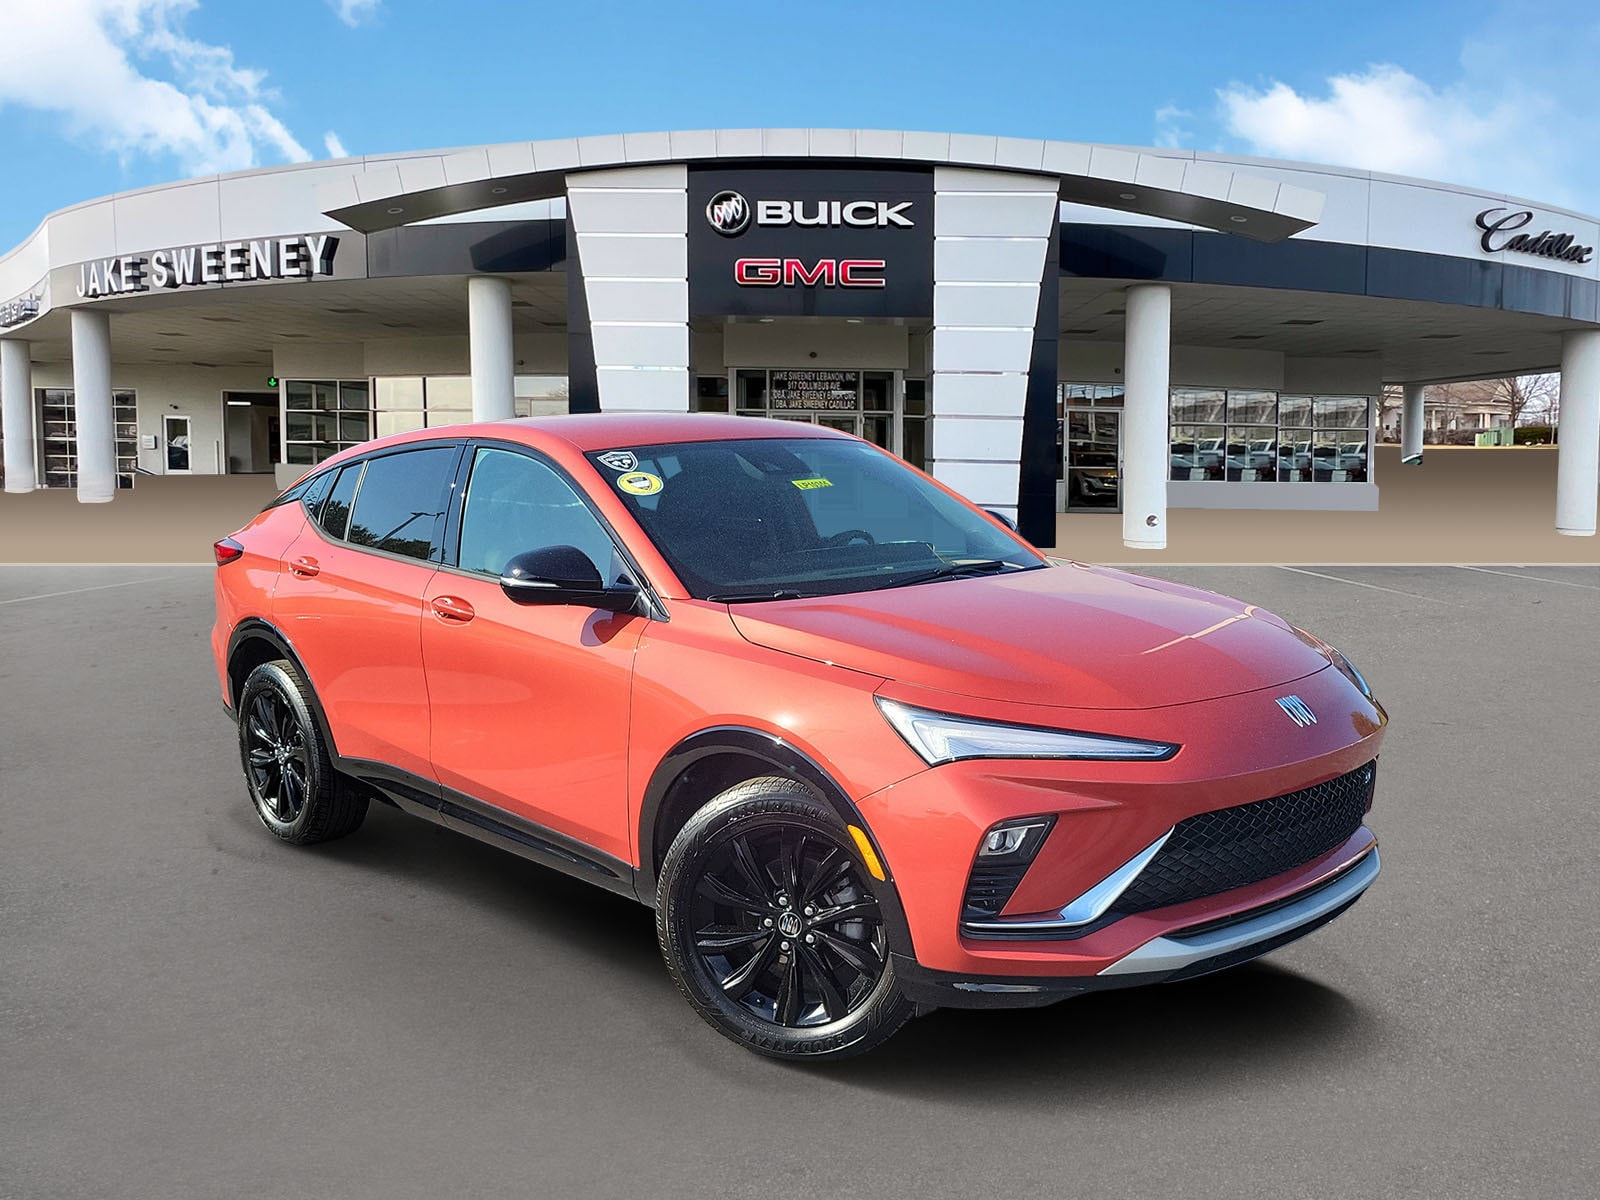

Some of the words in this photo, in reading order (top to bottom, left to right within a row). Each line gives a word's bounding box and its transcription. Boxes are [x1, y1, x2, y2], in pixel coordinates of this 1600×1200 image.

[757, 200, 915, 226] BUICK
[1475, 207, 1593, 264] Cadillac
[76, 255, 141, 298] JAKE
[151, 234, 331, 289] SWEENEY
[735, 258, 886, 287] GMC
[773, 372, 788, 380] JAKE
[788, 372, 815, 380] SWEENEY
[787, 381, 798, 390] 917
[787, 390, 801, 400] JAKE
[801, 390, 826, 400] SWEENEY
[789, 400, 803, 409] JAKE
[803, 400, 828, 409] SWEENEY
[828, 400, 855, 409] CADILLAC
